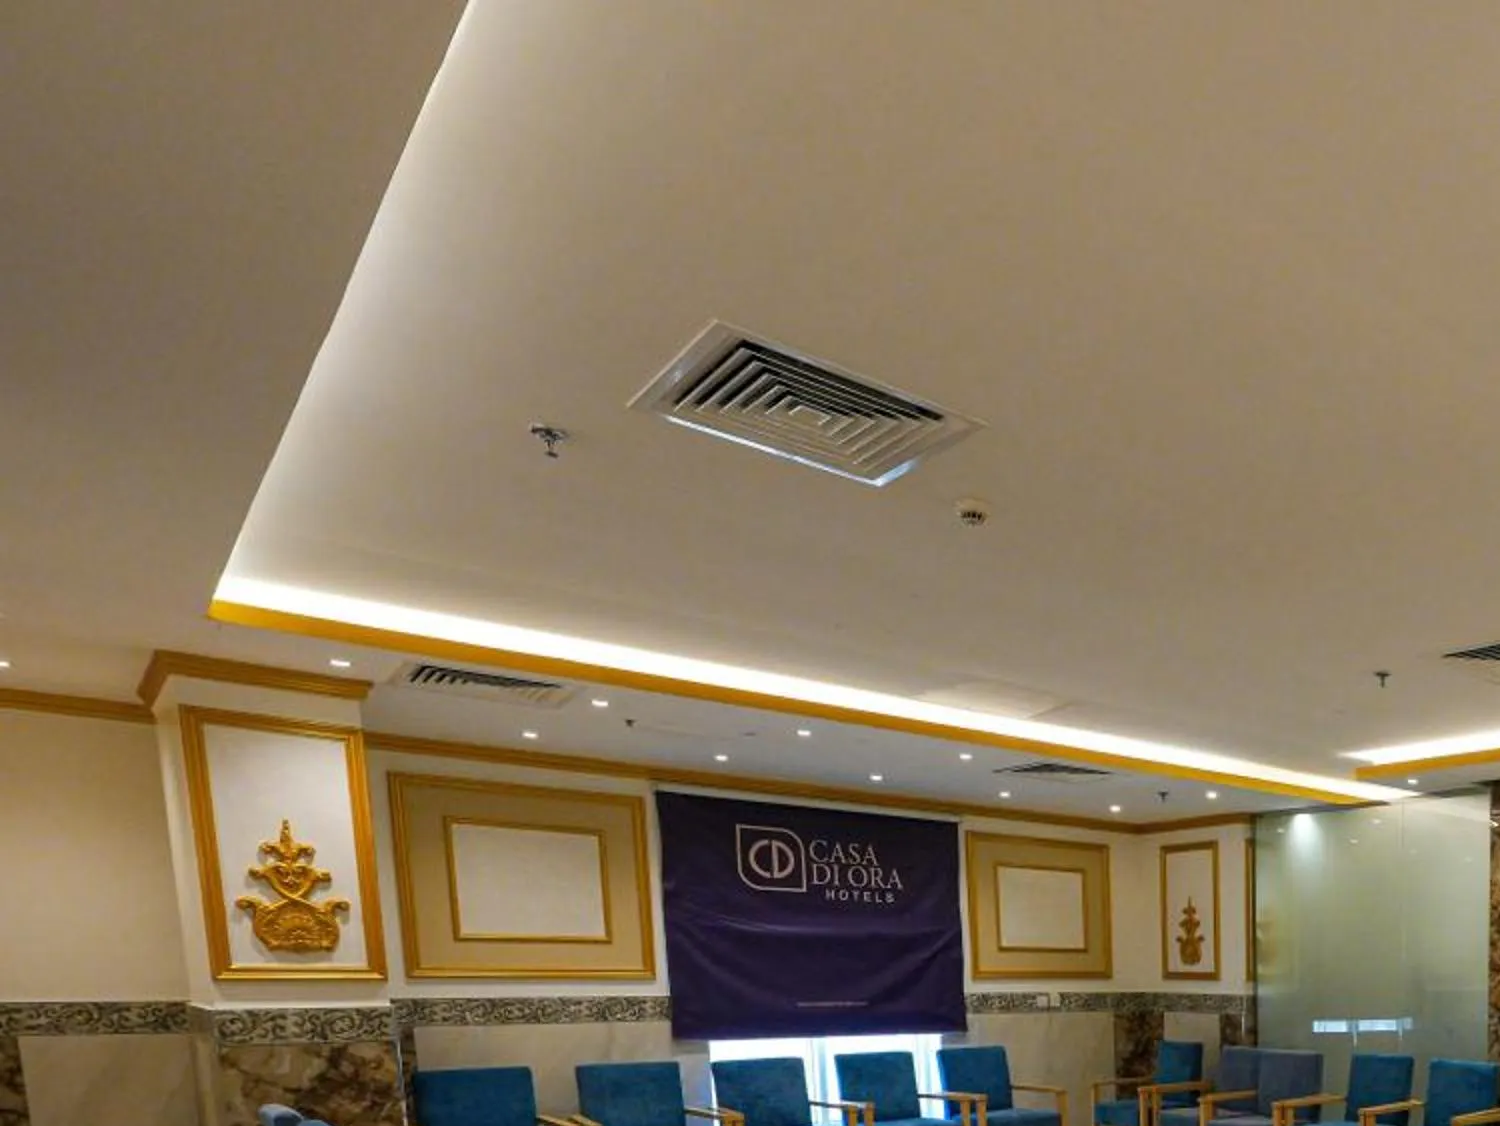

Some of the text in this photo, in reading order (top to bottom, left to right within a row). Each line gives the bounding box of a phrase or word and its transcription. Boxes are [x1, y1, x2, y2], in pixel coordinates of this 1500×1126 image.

[809, 839, 880, 867] CASA
[811, 863, 903, 890] DI ORA
[825, 888, 896, 903] HOTELS
